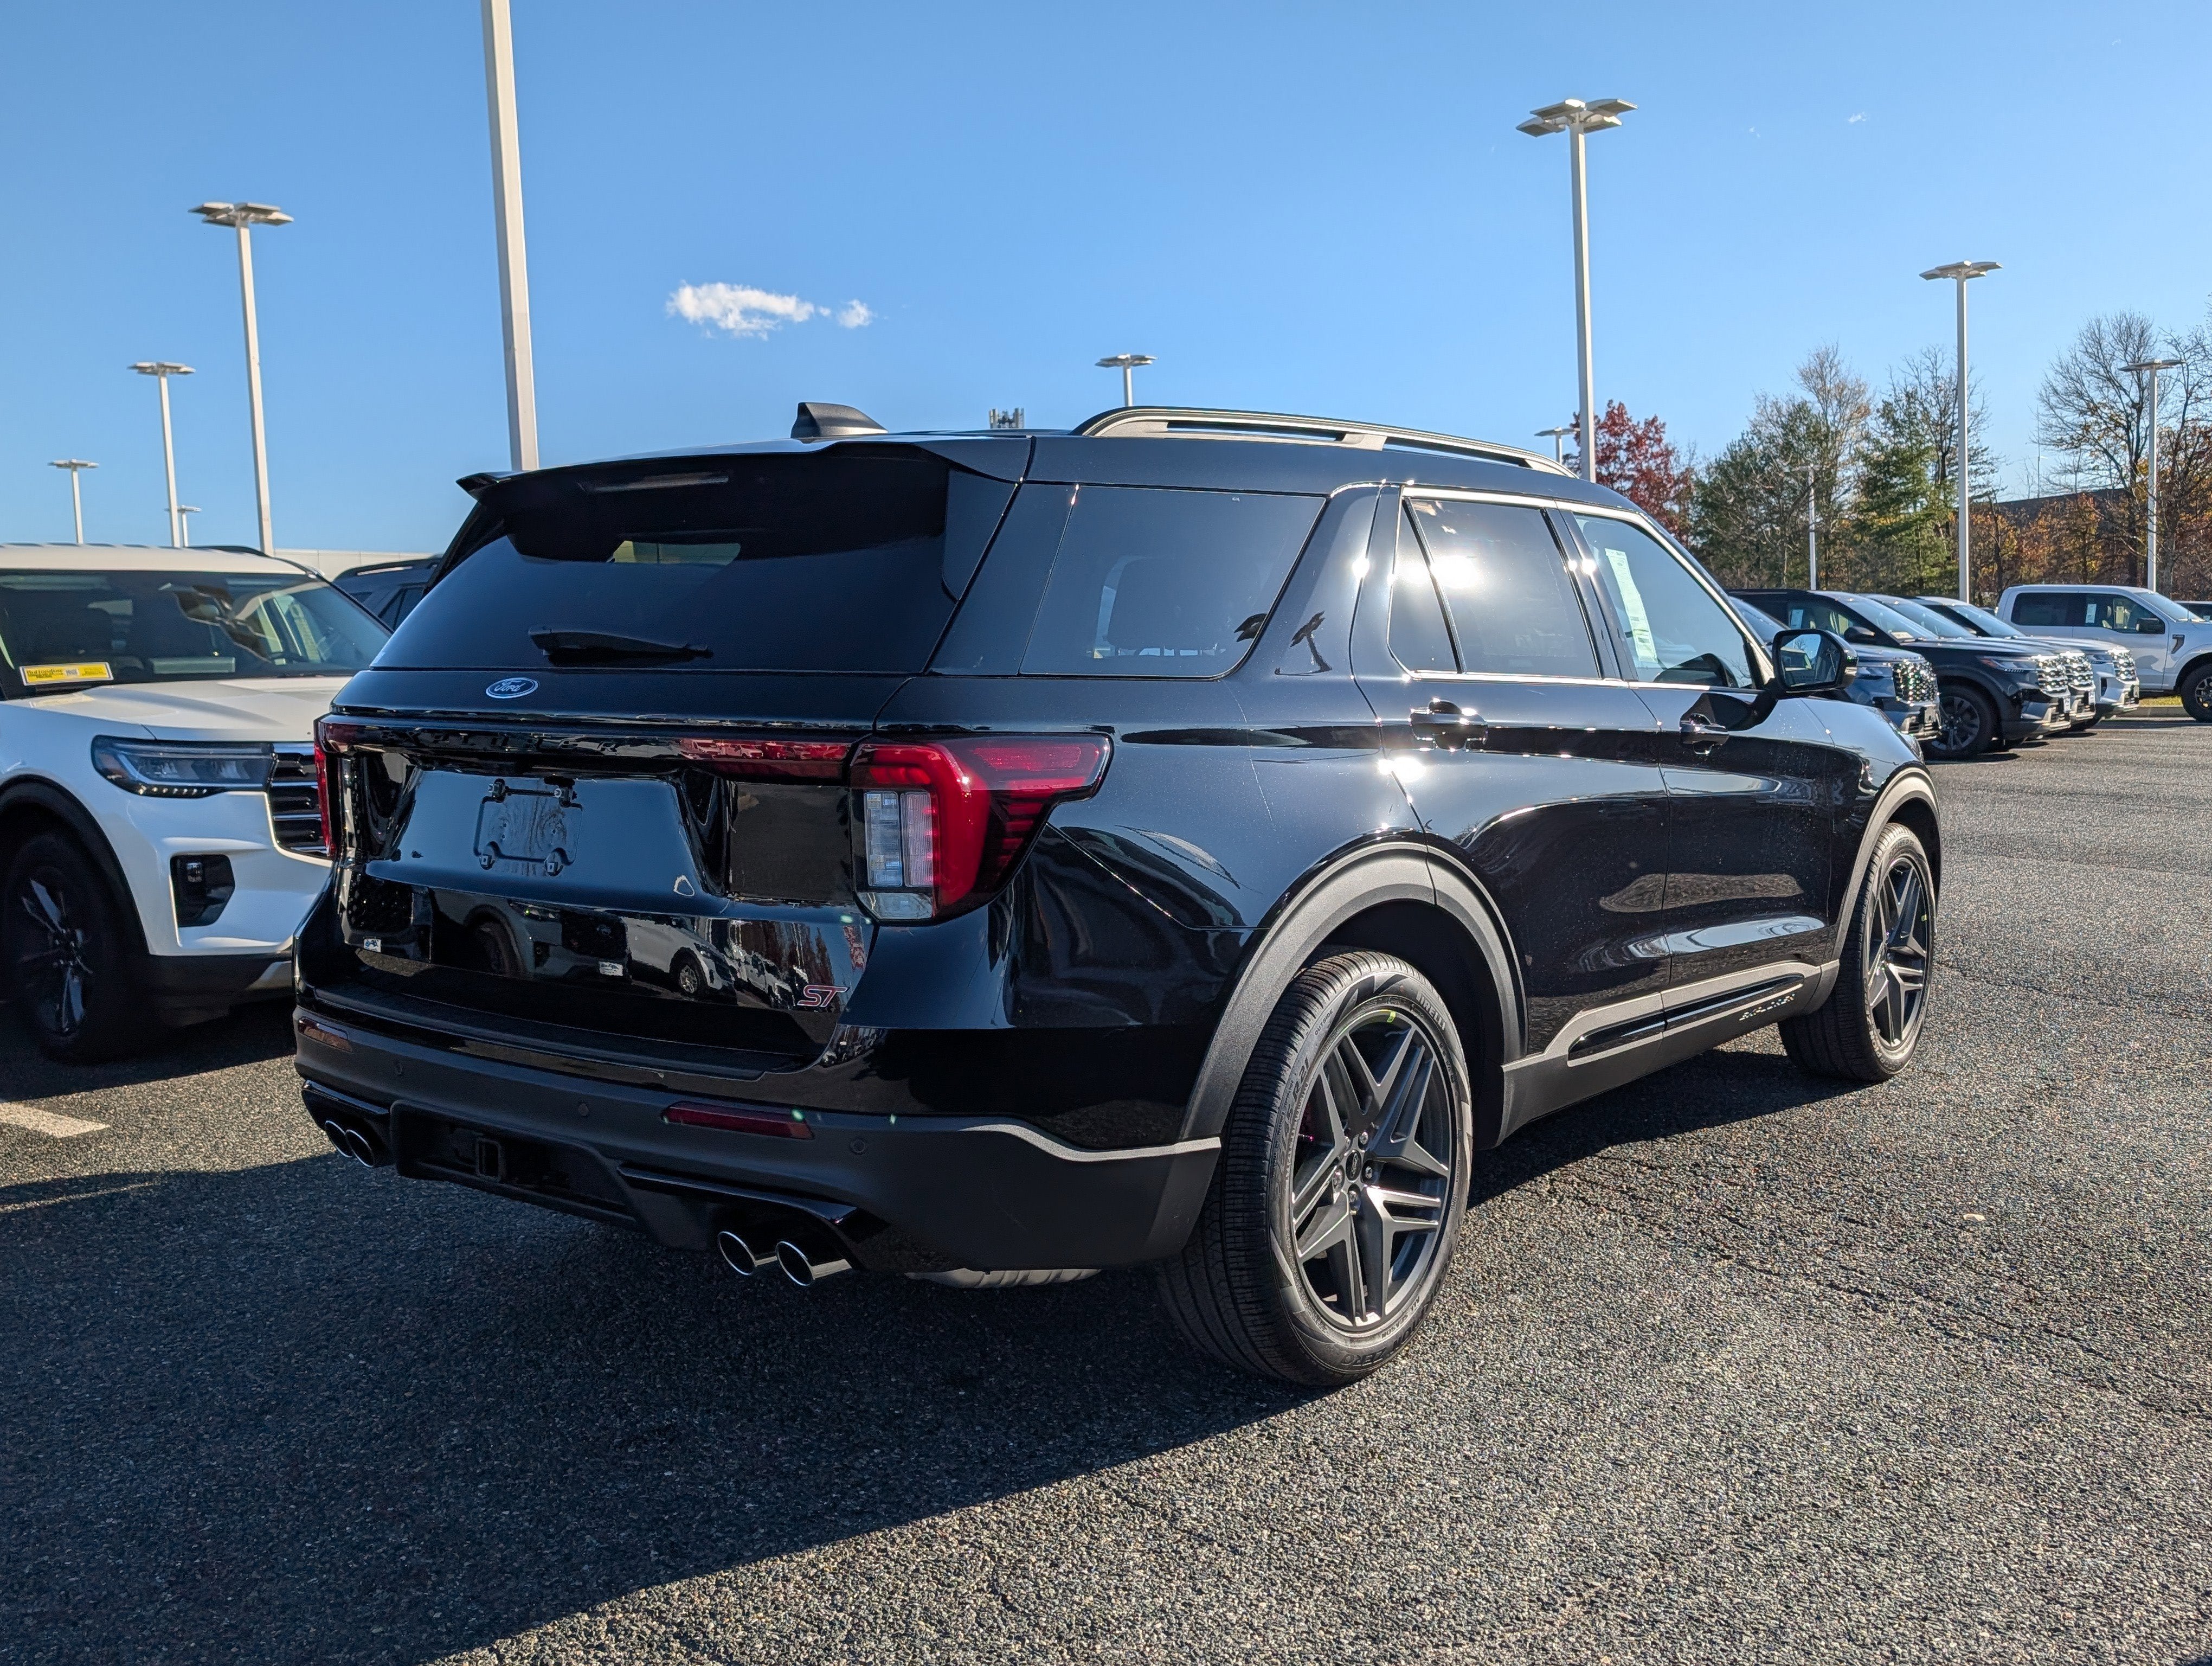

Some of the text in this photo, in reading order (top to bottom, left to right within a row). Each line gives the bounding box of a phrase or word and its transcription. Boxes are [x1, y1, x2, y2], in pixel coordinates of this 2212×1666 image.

[494, 680, 526, 691] Ford
[797, 985, 848, 1007] ST
[1416, 987, 1446, 1030] PIRELLI
[1315, 1009, 1333, 1035] OUTSIDE
[1291, 1056, 1309, 1102] R21
[1381, 1295, 1420, 1338] ALL SEASON
[1341, 1347, 1388, 1367] ZERO
